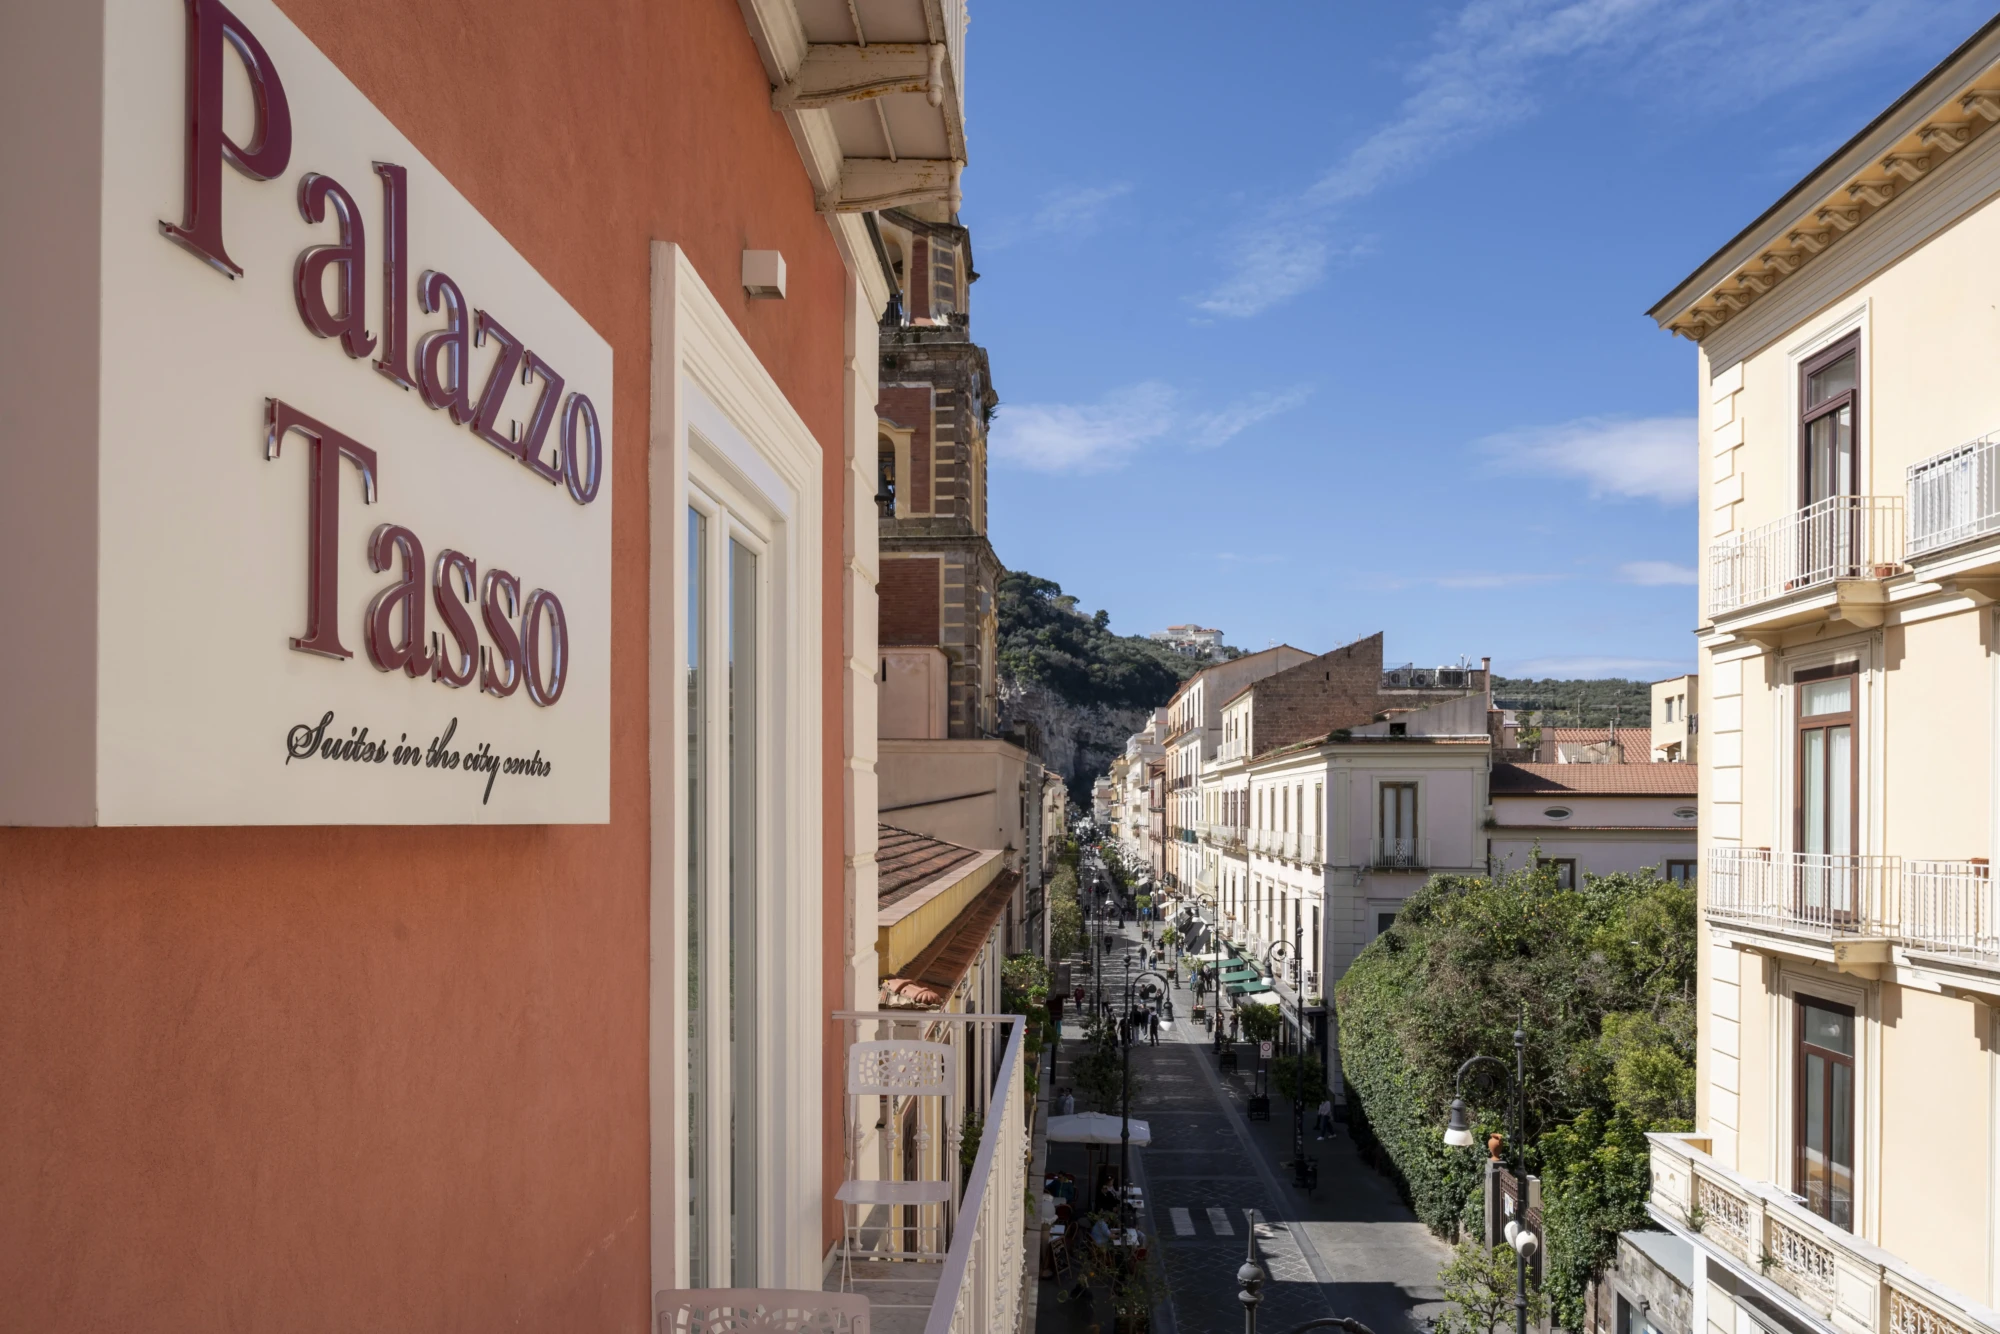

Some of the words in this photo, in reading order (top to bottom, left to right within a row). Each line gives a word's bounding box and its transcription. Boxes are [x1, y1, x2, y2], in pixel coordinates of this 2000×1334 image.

[158, 0, 603, 505] Palazzo
[263, 397, 569, 707] Tasso
[286, 710, 388, 766] Suites
[393, 732, 421, 766] in
[426, 717, 460, 769] the
[463, 743, 500, 805] city
[503, 749, 551, 777] centre
